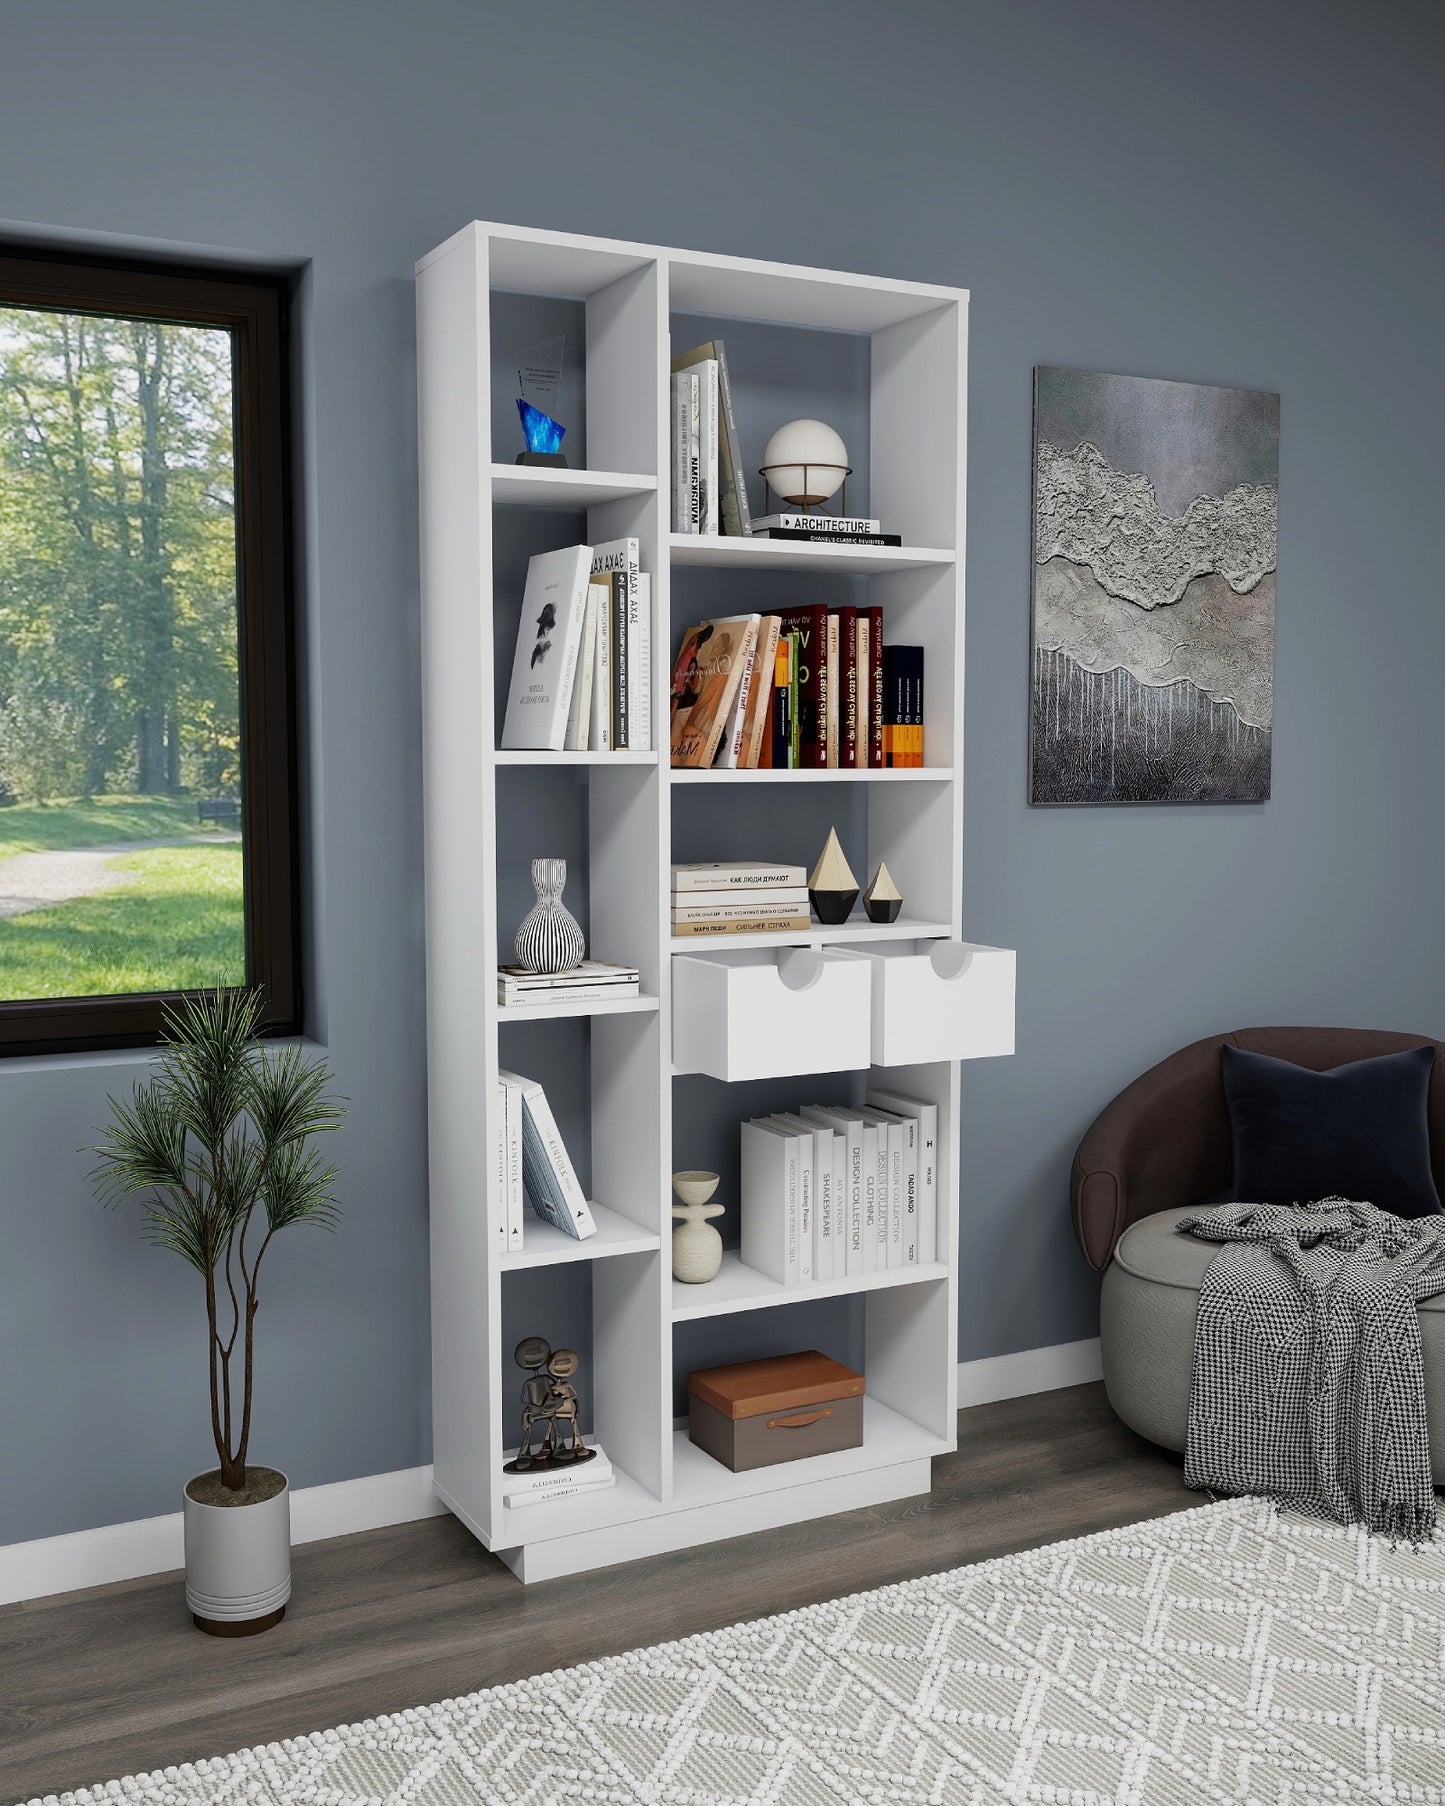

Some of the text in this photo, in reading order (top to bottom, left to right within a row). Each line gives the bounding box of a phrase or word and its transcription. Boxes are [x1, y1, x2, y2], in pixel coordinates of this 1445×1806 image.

[794, 518, 871, 533] ARCHITECTURE
[810, 535, 835, 543] CHANEL'S
[742, 876, 762, 884] ЛЮДИ
[762, 875, 789, 883] ДУМАЮТ
[736, 923, 766, 931] СИЛЬНЕЕ
[768, 921, 791, 929] СТРАХА
[549, 1139, 568, 1177] KINFOLK
[878, 1150, 887, 1243] DESIGN COLLECTION
